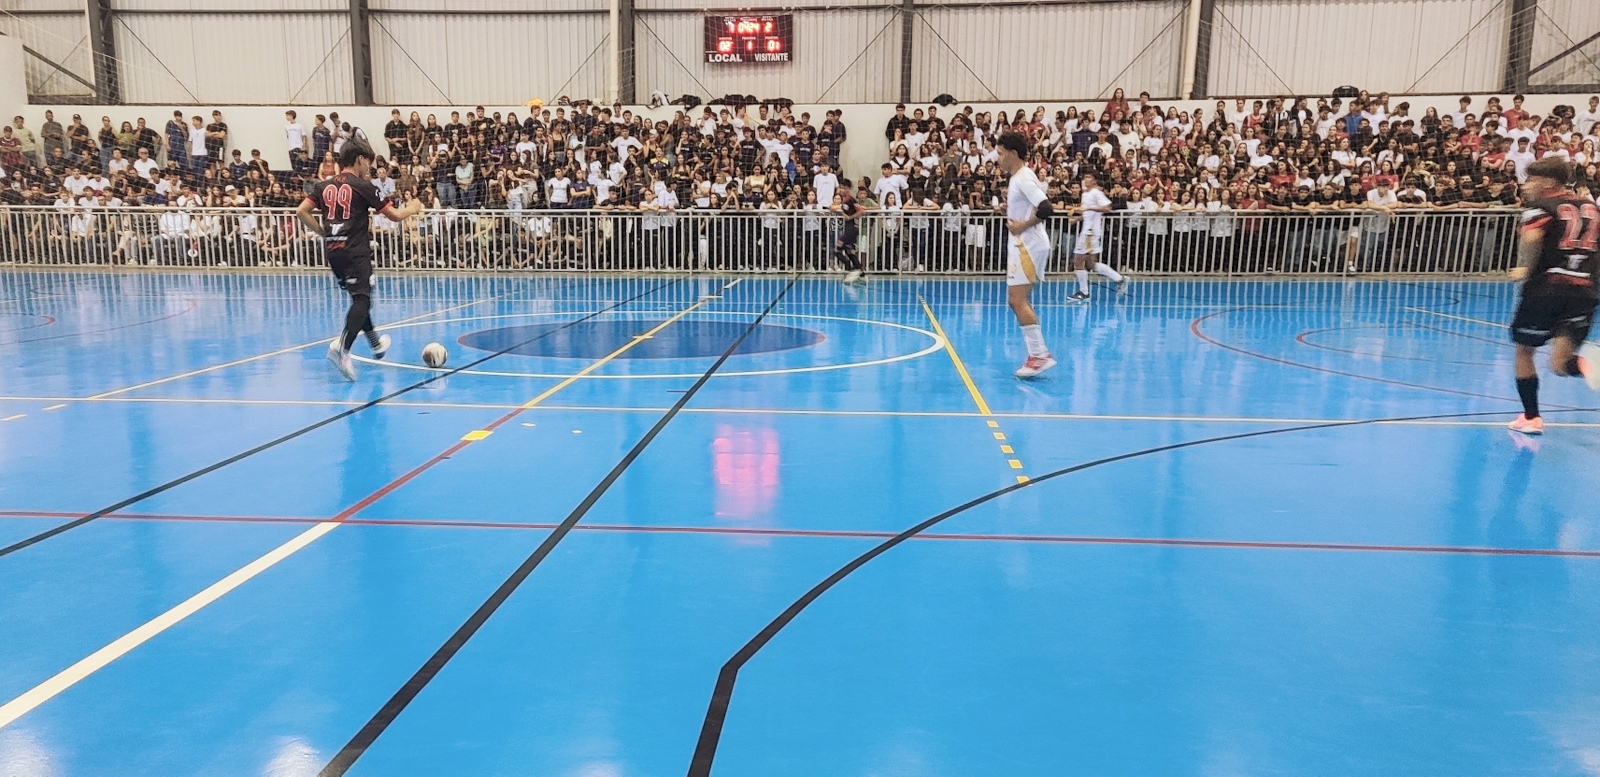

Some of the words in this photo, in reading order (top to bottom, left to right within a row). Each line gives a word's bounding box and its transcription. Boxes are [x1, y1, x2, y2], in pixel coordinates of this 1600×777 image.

[764, 22, 773, 33] 2
[718, 40, 732, 51] 02
[709, 54, 742, 62] LOCAL
[755, 53, 788, 61] VISITANTE
[322, 183, 353, 220] 99
[1556, 203, 1600, 251] 22
